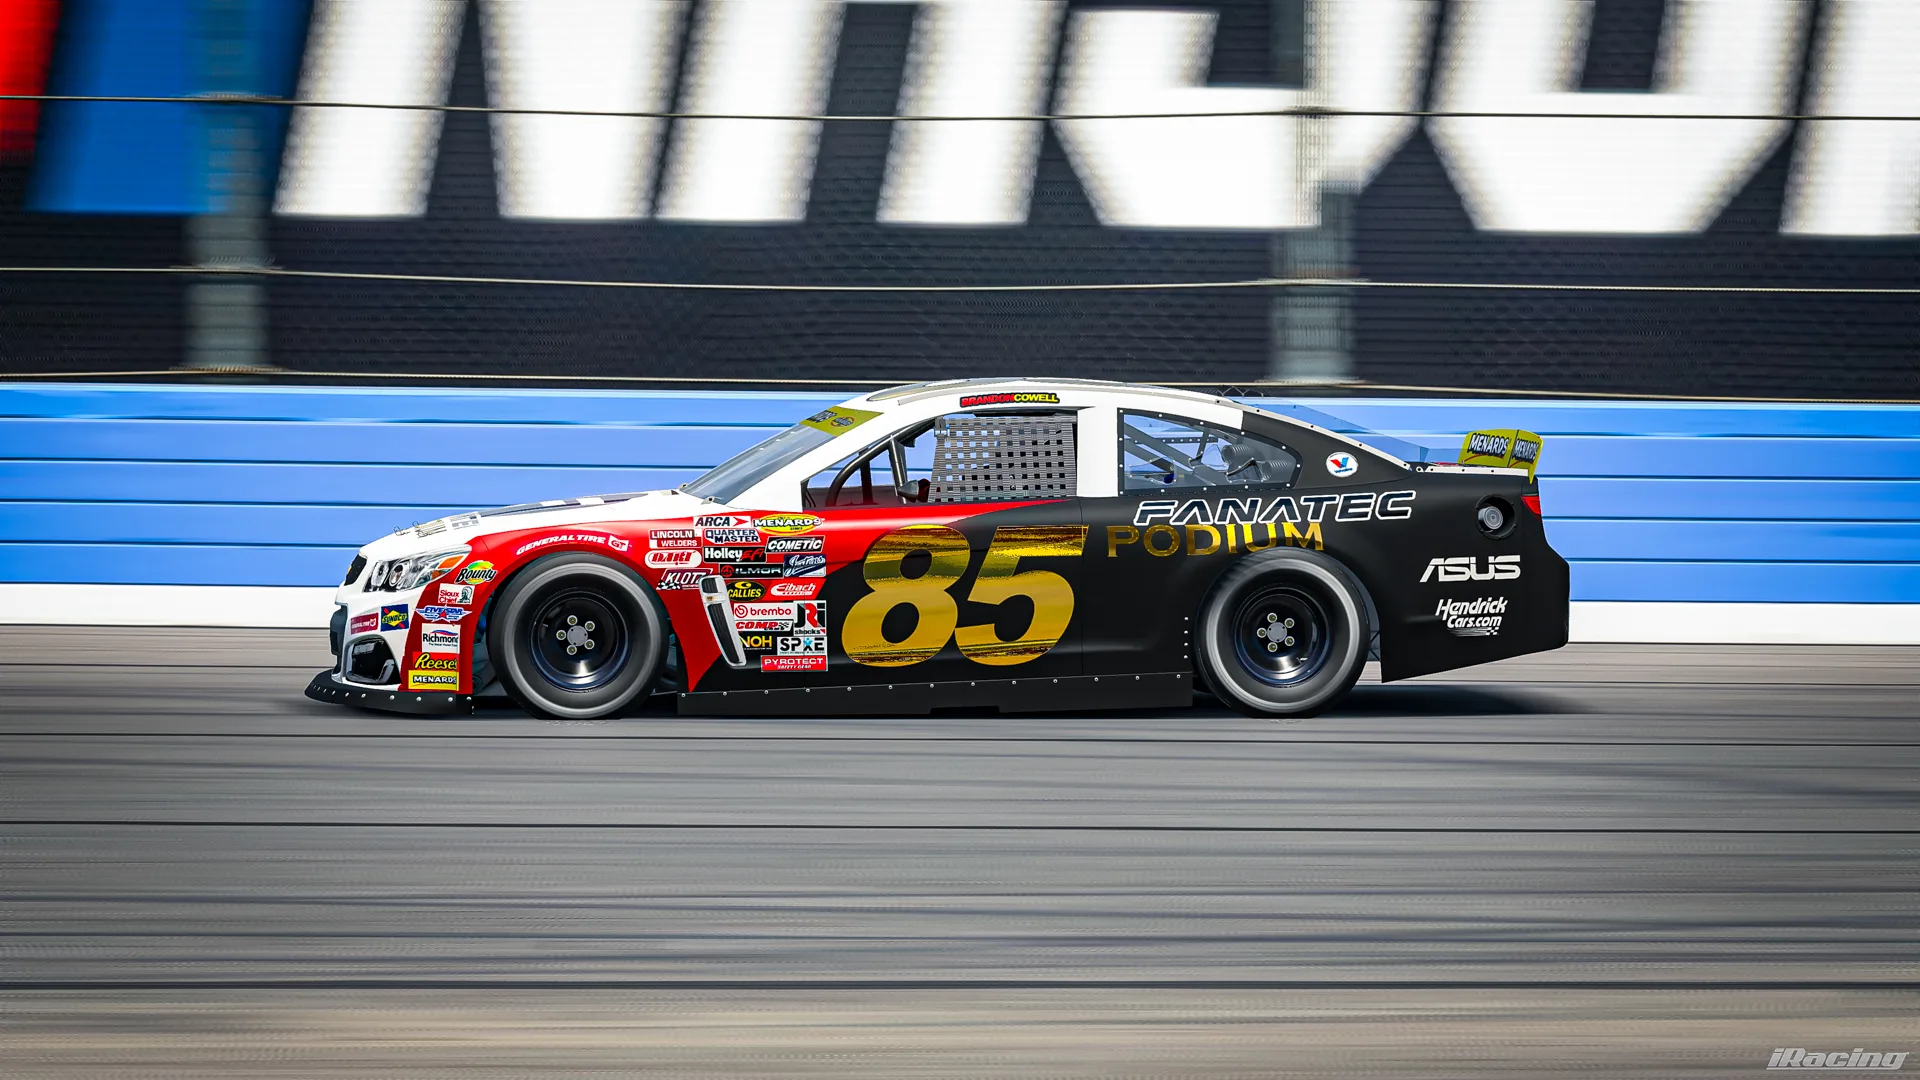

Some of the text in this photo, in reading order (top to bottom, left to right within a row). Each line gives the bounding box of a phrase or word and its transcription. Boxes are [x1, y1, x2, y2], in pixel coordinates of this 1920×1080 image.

[1467, 433, 1509, 457] MENARDS
[1512, 438, 1539, 463] MENARDS
[1133, 490, 1416, 526] FANATEC
[695, 517, 730, 527] ARCA
[753, 518, 821, 527] MENARDS
[651, 530, 693, 539] LINCOLN
[705, 530, 756, 540] QUARTER
[714, 536, 759, 544] MASTER
[1106, 521, 1325, 558] PODIUM
[516, 535, 575, 555] GENERAL
[576, 534, 606, 545] TIRE
[704, 548, 743, 562] Holley
[455, 568, 498, 583] Bounty
[1420, 555, 1521, 582] ASUS
[771, 583, 816, 596] Eibach
[841, 524, 1089, 667] 85
[750, 607, 792, 616] brembo
[1435, 597, 1508, 620] Hendrick
[735, 621, 778, 630] COMP
[1447, 616, 1502, 628] Cars.com
